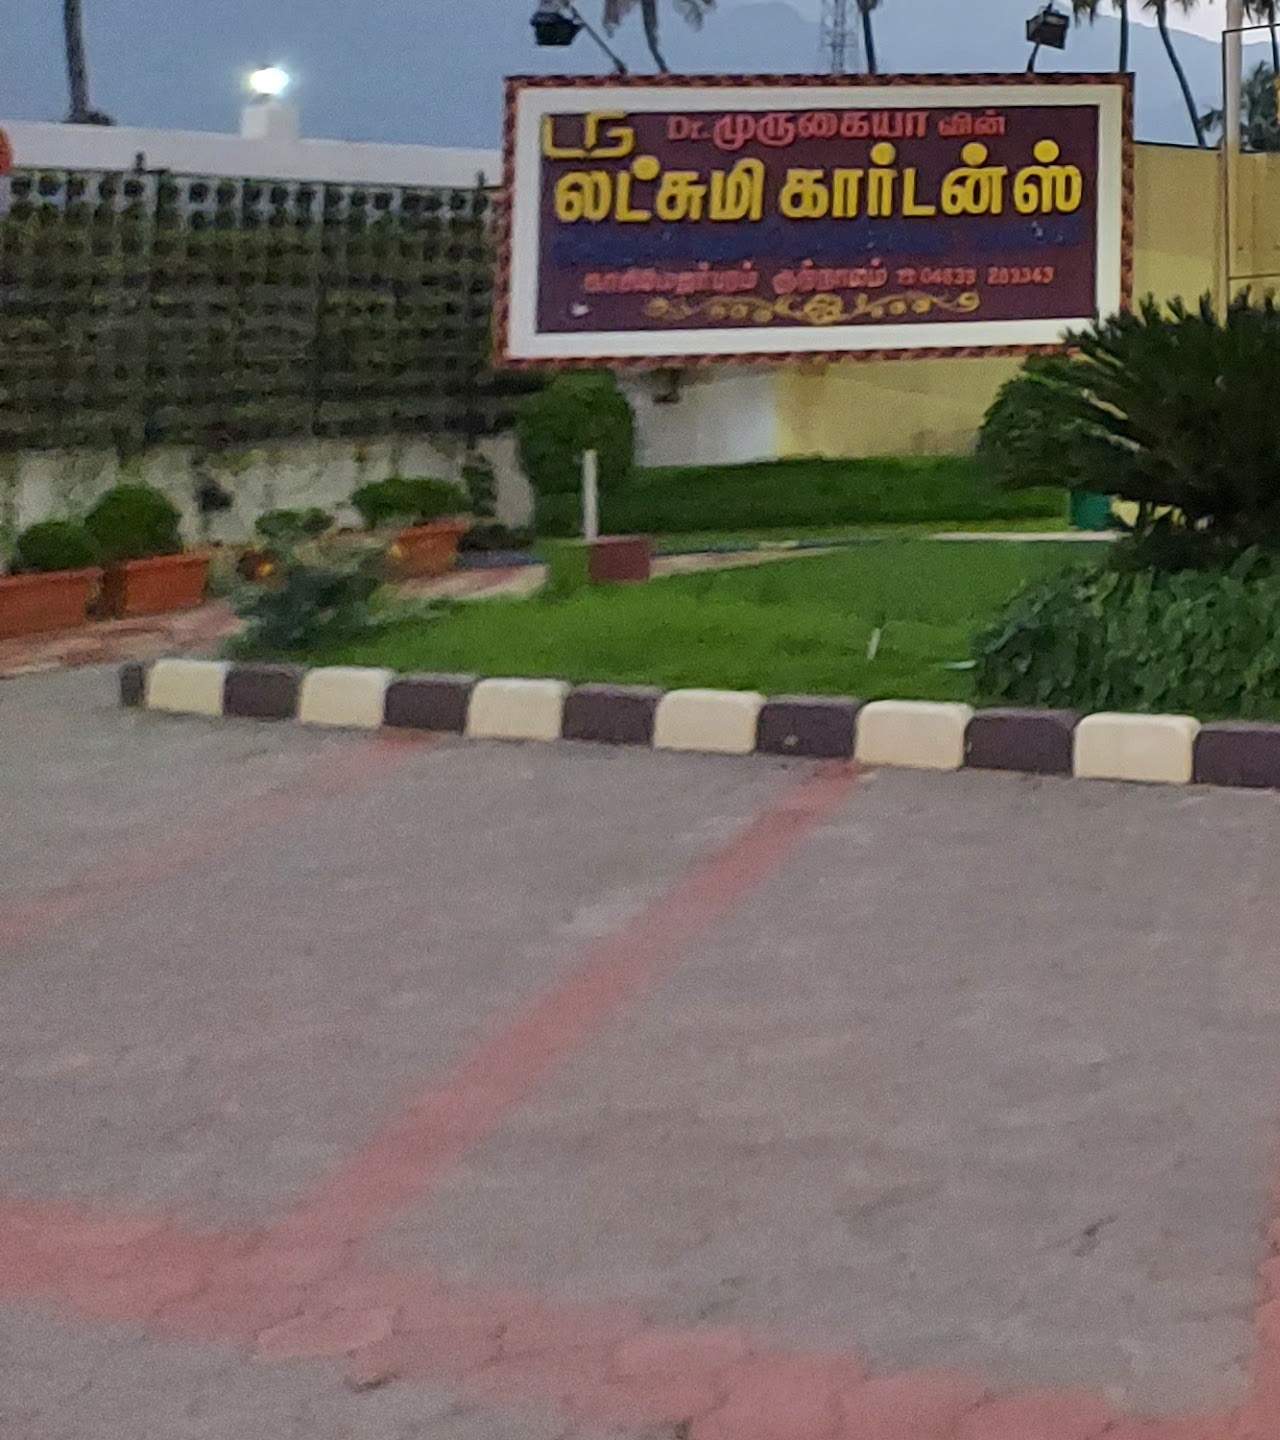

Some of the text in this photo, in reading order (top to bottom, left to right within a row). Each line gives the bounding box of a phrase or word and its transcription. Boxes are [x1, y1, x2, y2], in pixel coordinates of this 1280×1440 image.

[937, 110, 1007, 138] வின்
[554, 139, 1084, 223] லட்சுமி கார்டன்ஸ்
